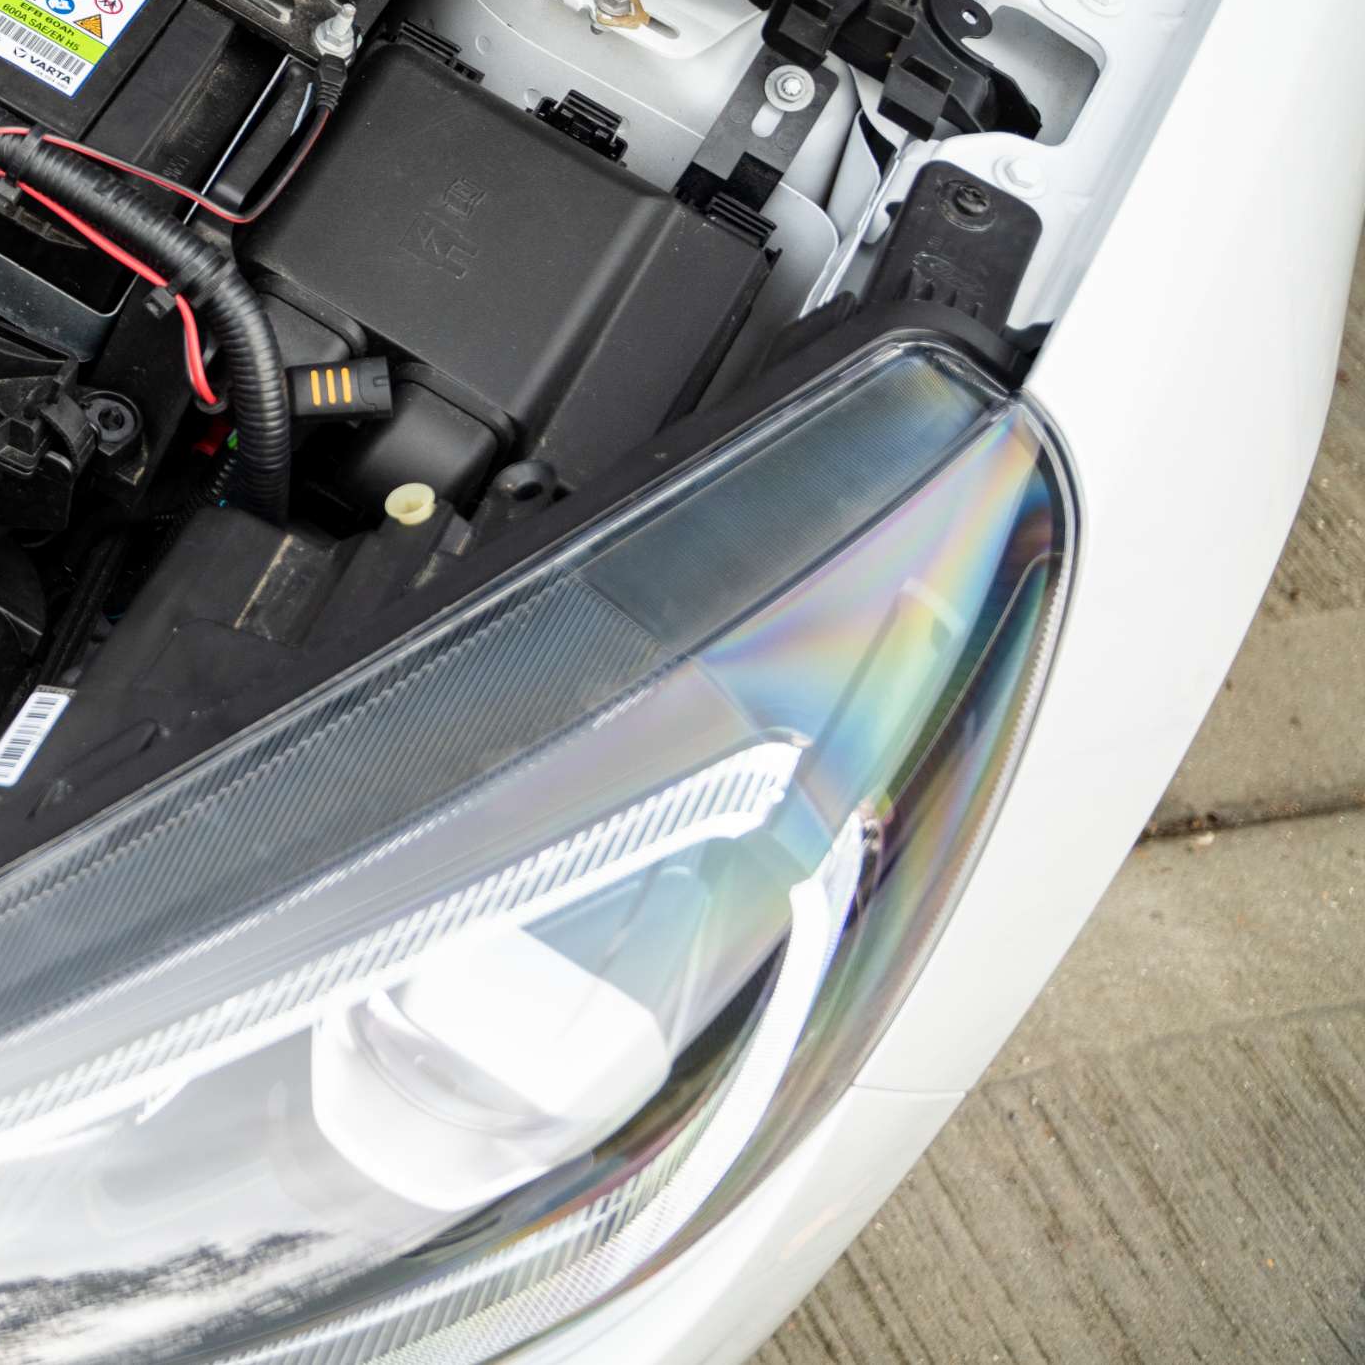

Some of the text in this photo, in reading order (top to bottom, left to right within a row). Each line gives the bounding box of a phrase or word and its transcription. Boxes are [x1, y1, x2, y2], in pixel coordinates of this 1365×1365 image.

[2, 4, 80, 51] 600A SAE/EN H5
[20, 2, 75, 35] EFB 60Ah
[30, 56, 71, 85] VARTA
